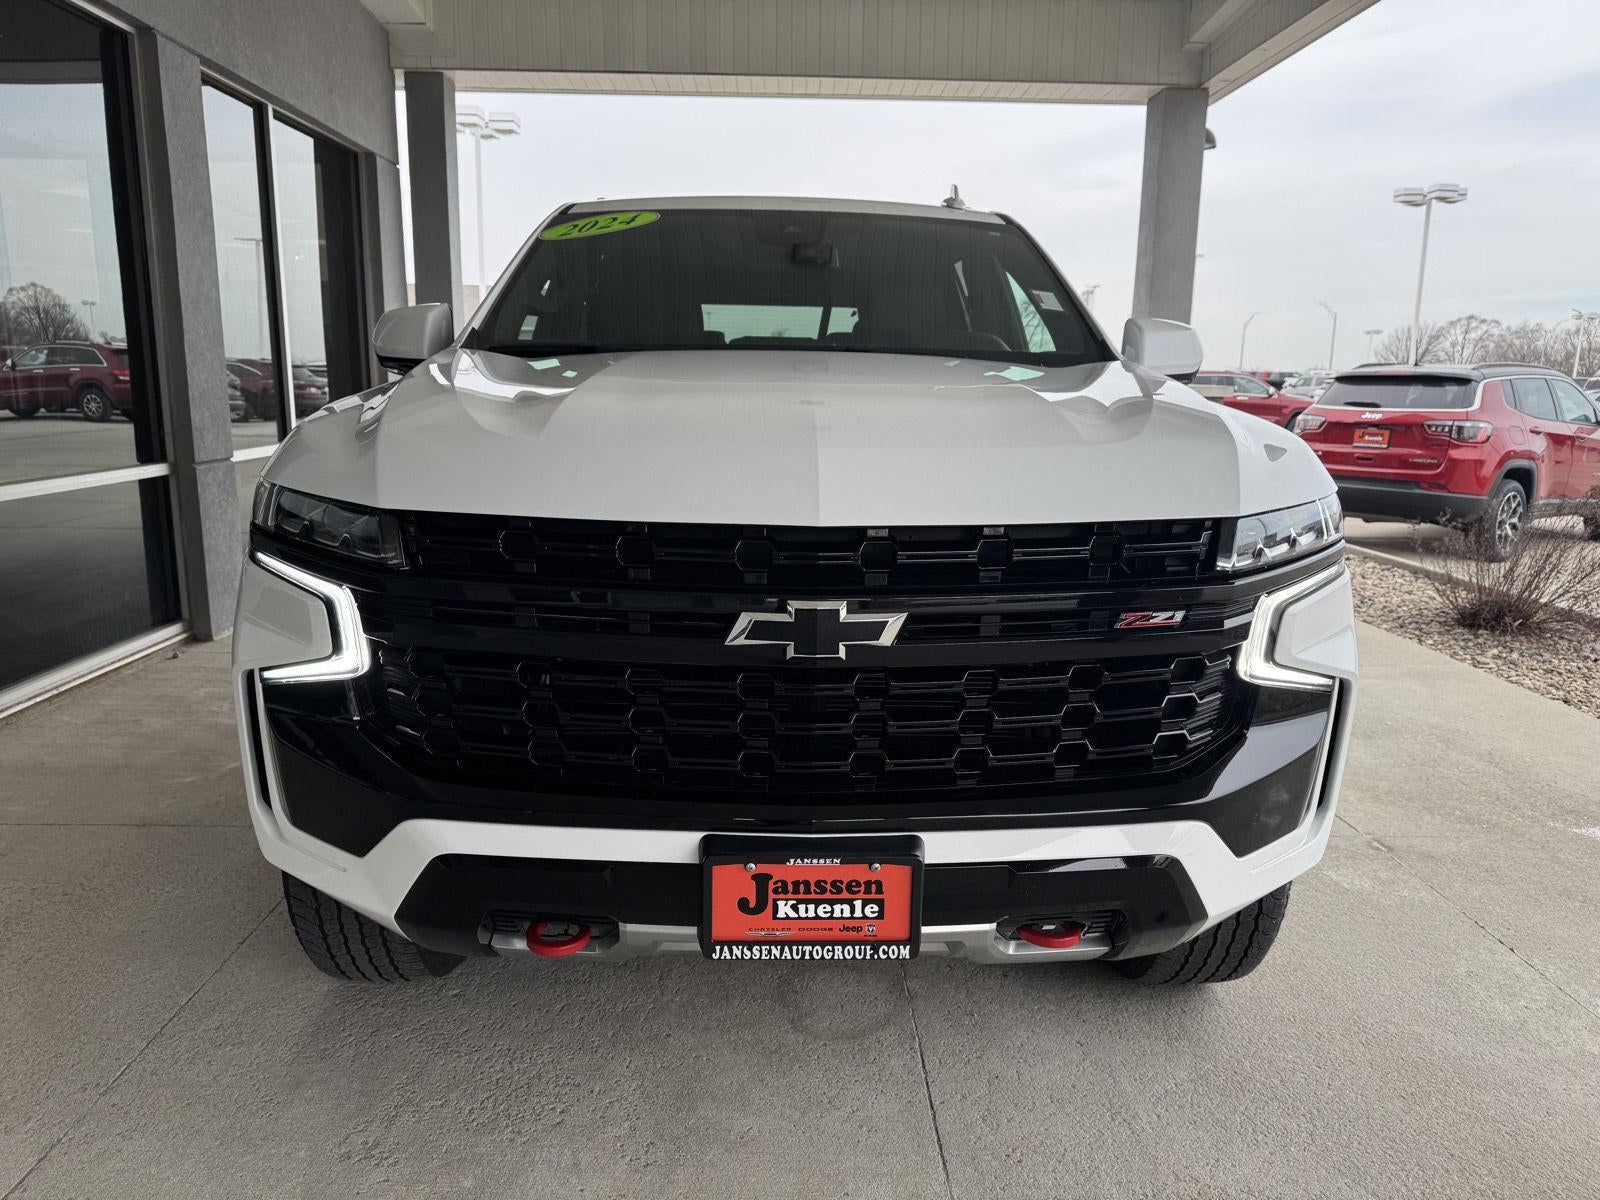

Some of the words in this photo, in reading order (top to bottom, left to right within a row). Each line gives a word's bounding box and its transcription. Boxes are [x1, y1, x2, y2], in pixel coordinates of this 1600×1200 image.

[558, 213, 641, 237] 2024
[1361, 411, 1383, 420] Jeep
[1113, 610, 1187, 629] Z71
[786, 858, 841, 866] JANSSEN
[737, 872, 884, 916] Janssen
[776, 899, 879, 918] Kuenle
[838, 924, 863, 934] Jeep
